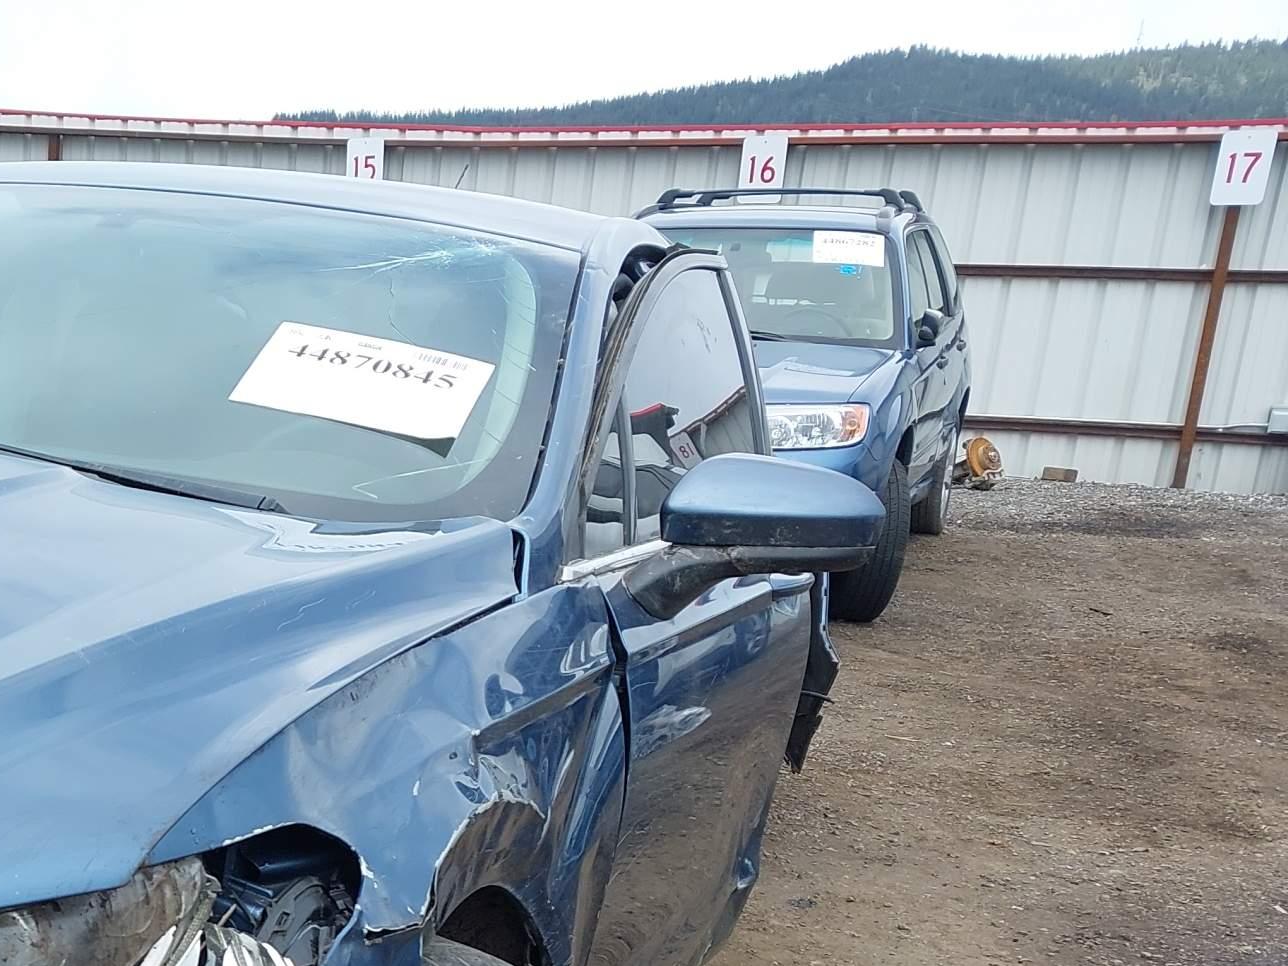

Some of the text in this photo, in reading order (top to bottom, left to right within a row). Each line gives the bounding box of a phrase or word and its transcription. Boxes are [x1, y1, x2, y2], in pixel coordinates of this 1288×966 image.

[353, 155, 376, 179] 15
[749, 155, 775, 183] 16
[1226, 152, 1262, 183] 17
[287, 343, 459, 390] 44870845
